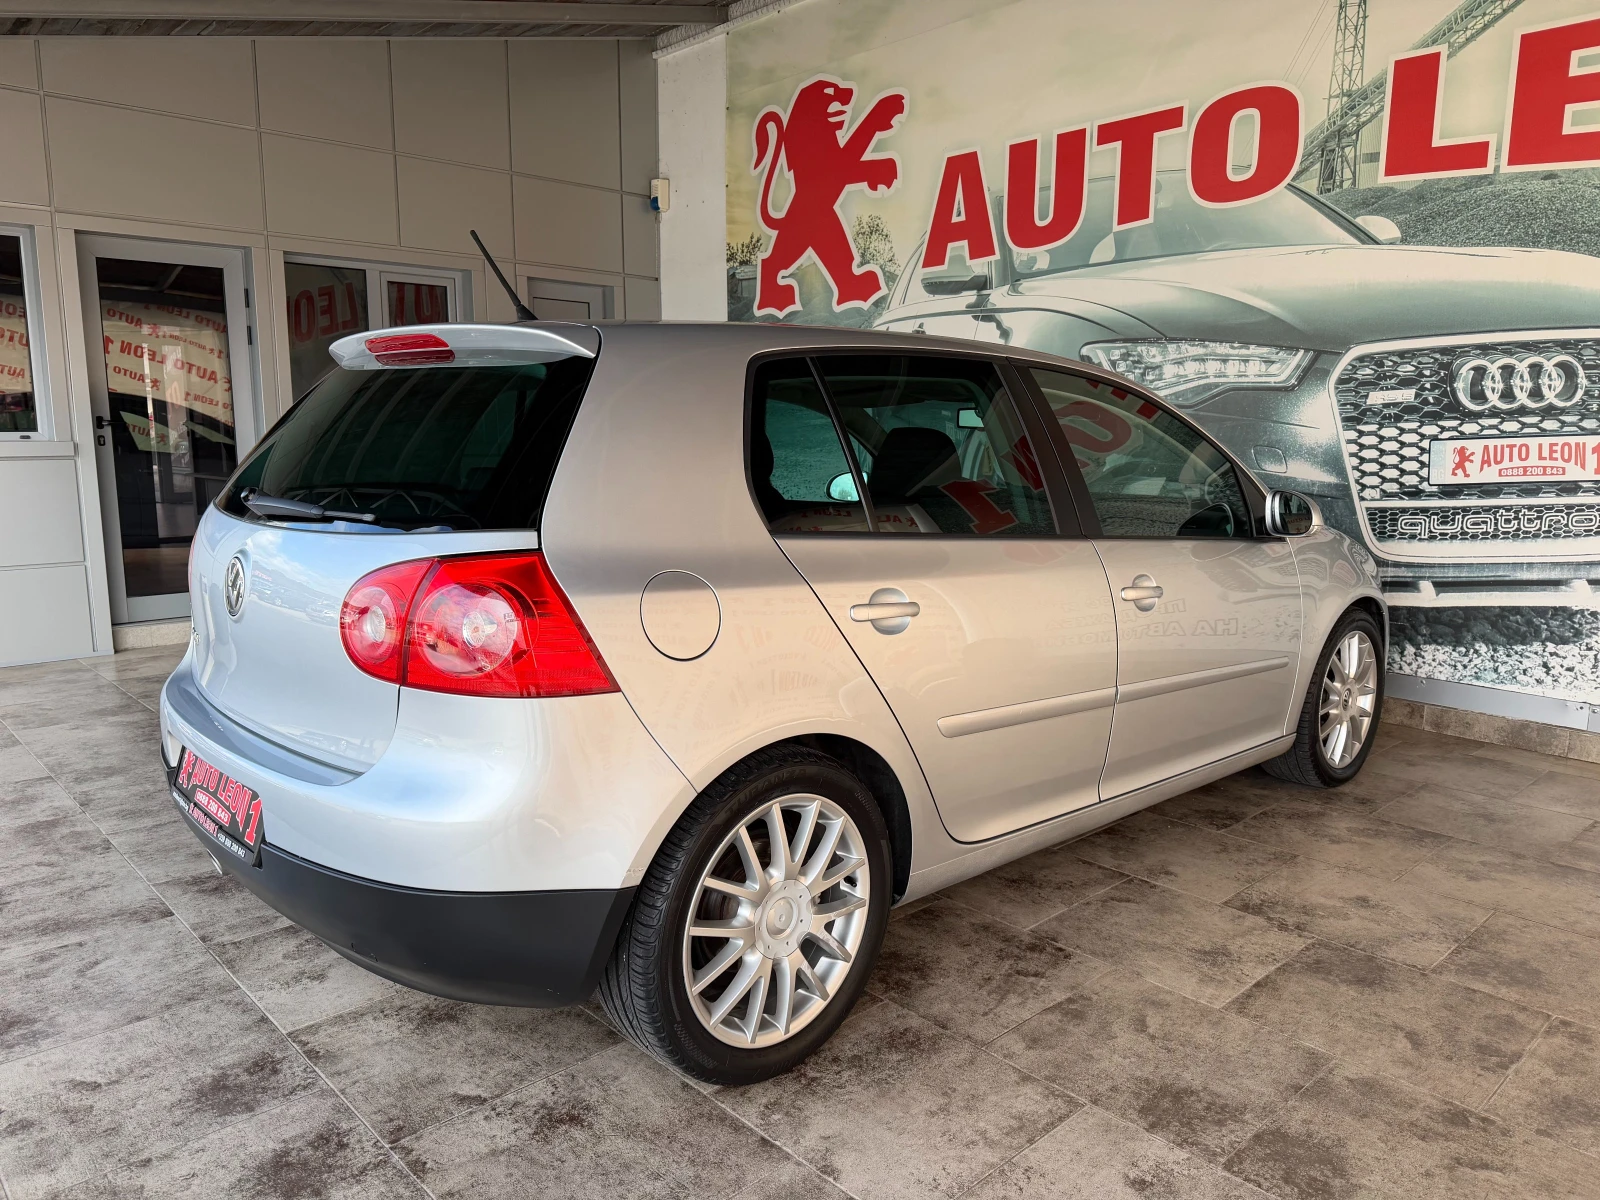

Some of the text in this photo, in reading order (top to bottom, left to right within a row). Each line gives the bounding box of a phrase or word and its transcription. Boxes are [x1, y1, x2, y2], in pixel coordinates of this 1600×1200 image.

[922, 85, 1300, 270] AUTO
[1479, 443, 1530, 474] AUTO
[1537, 441, 1587, 472] LEON
[1501, 466, 1563, 476] 0888 200 843
[1398, 508, 1600, 539] quattro
[188, 757, 220, 791] AUTO
[217, 773, 252, 832] LEON
[244, 797, 262, 846] 1
[208, 799, 218, 814] 200
[217, 806, 229, 822] 843
